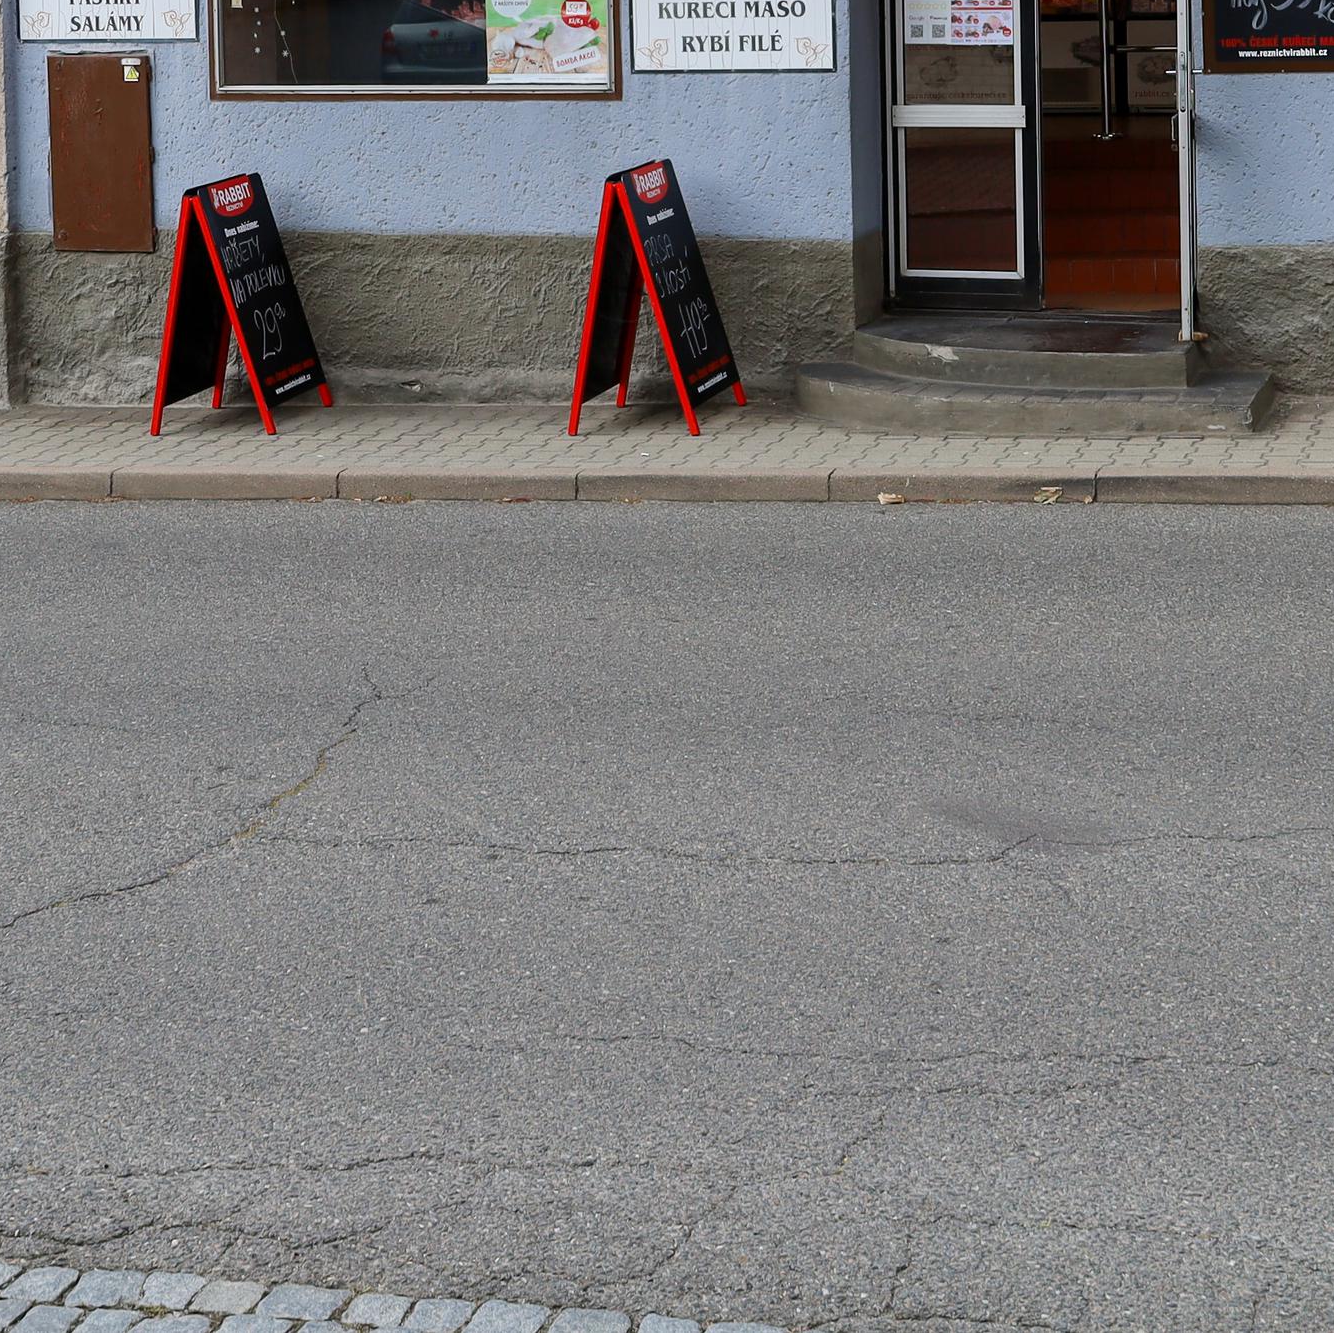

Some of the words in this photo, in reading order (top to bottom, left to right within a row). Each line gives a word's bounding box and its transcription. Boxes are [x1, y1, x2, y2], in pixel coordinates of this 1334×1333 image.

[744, 0, 806, 19] MASO
[70, 12, 144, 33] SALÁMY
[682, 31, 730, 52] RYBÍ
[739, 30, 783, 51] FILÉ
[1238, 48, 1328, 58] www.reznictvirabbit.cz
[639, 168, 666, 193] RABBIT
[218, 182, 251, 206] RABBIT
